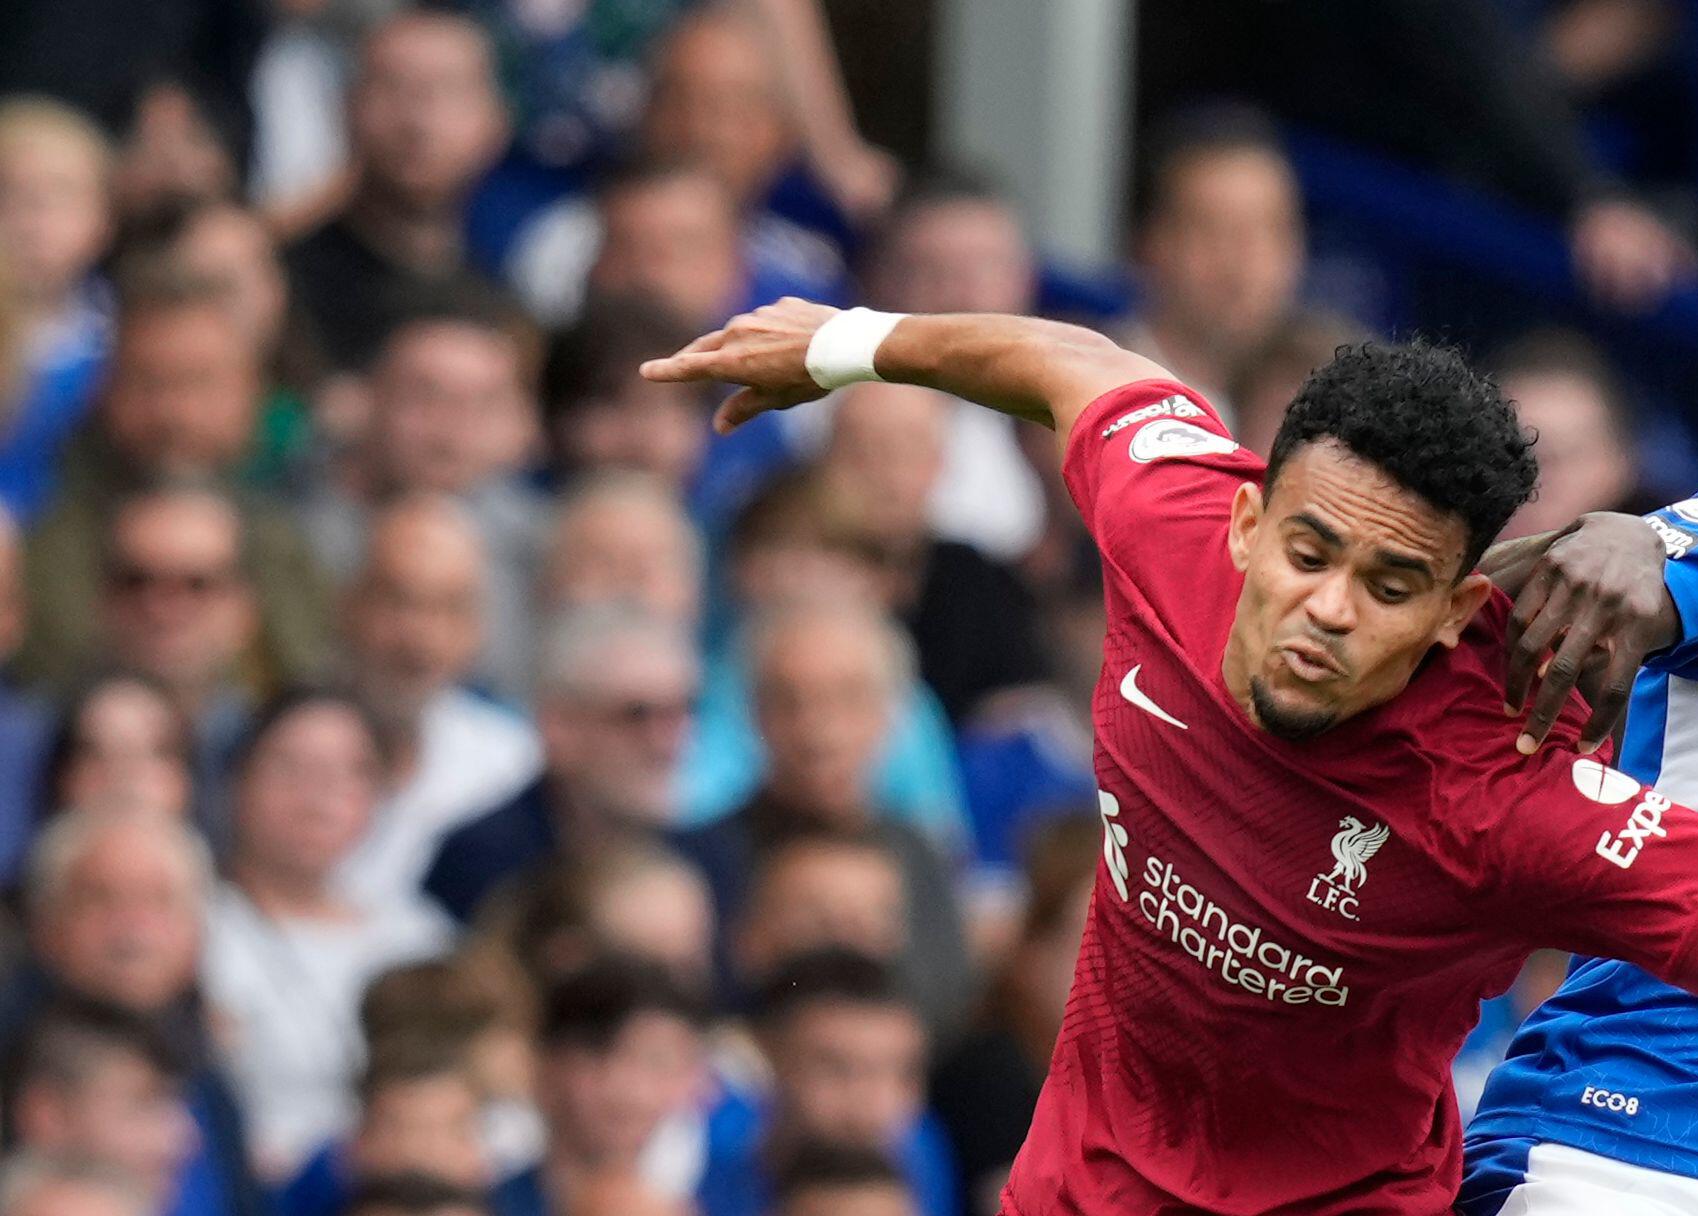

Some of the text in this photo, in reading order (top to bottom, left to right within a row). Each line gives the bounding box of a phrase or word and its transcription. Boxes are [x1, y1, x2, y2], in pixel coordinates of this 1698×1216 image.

[1143, 856, 1345, 988] standard
[1306, 878, 1361, 922] L.F.C.
[1138, 890, 1350, 1007] chartered
[1581, 1086, 1640, 1116] ECO8
